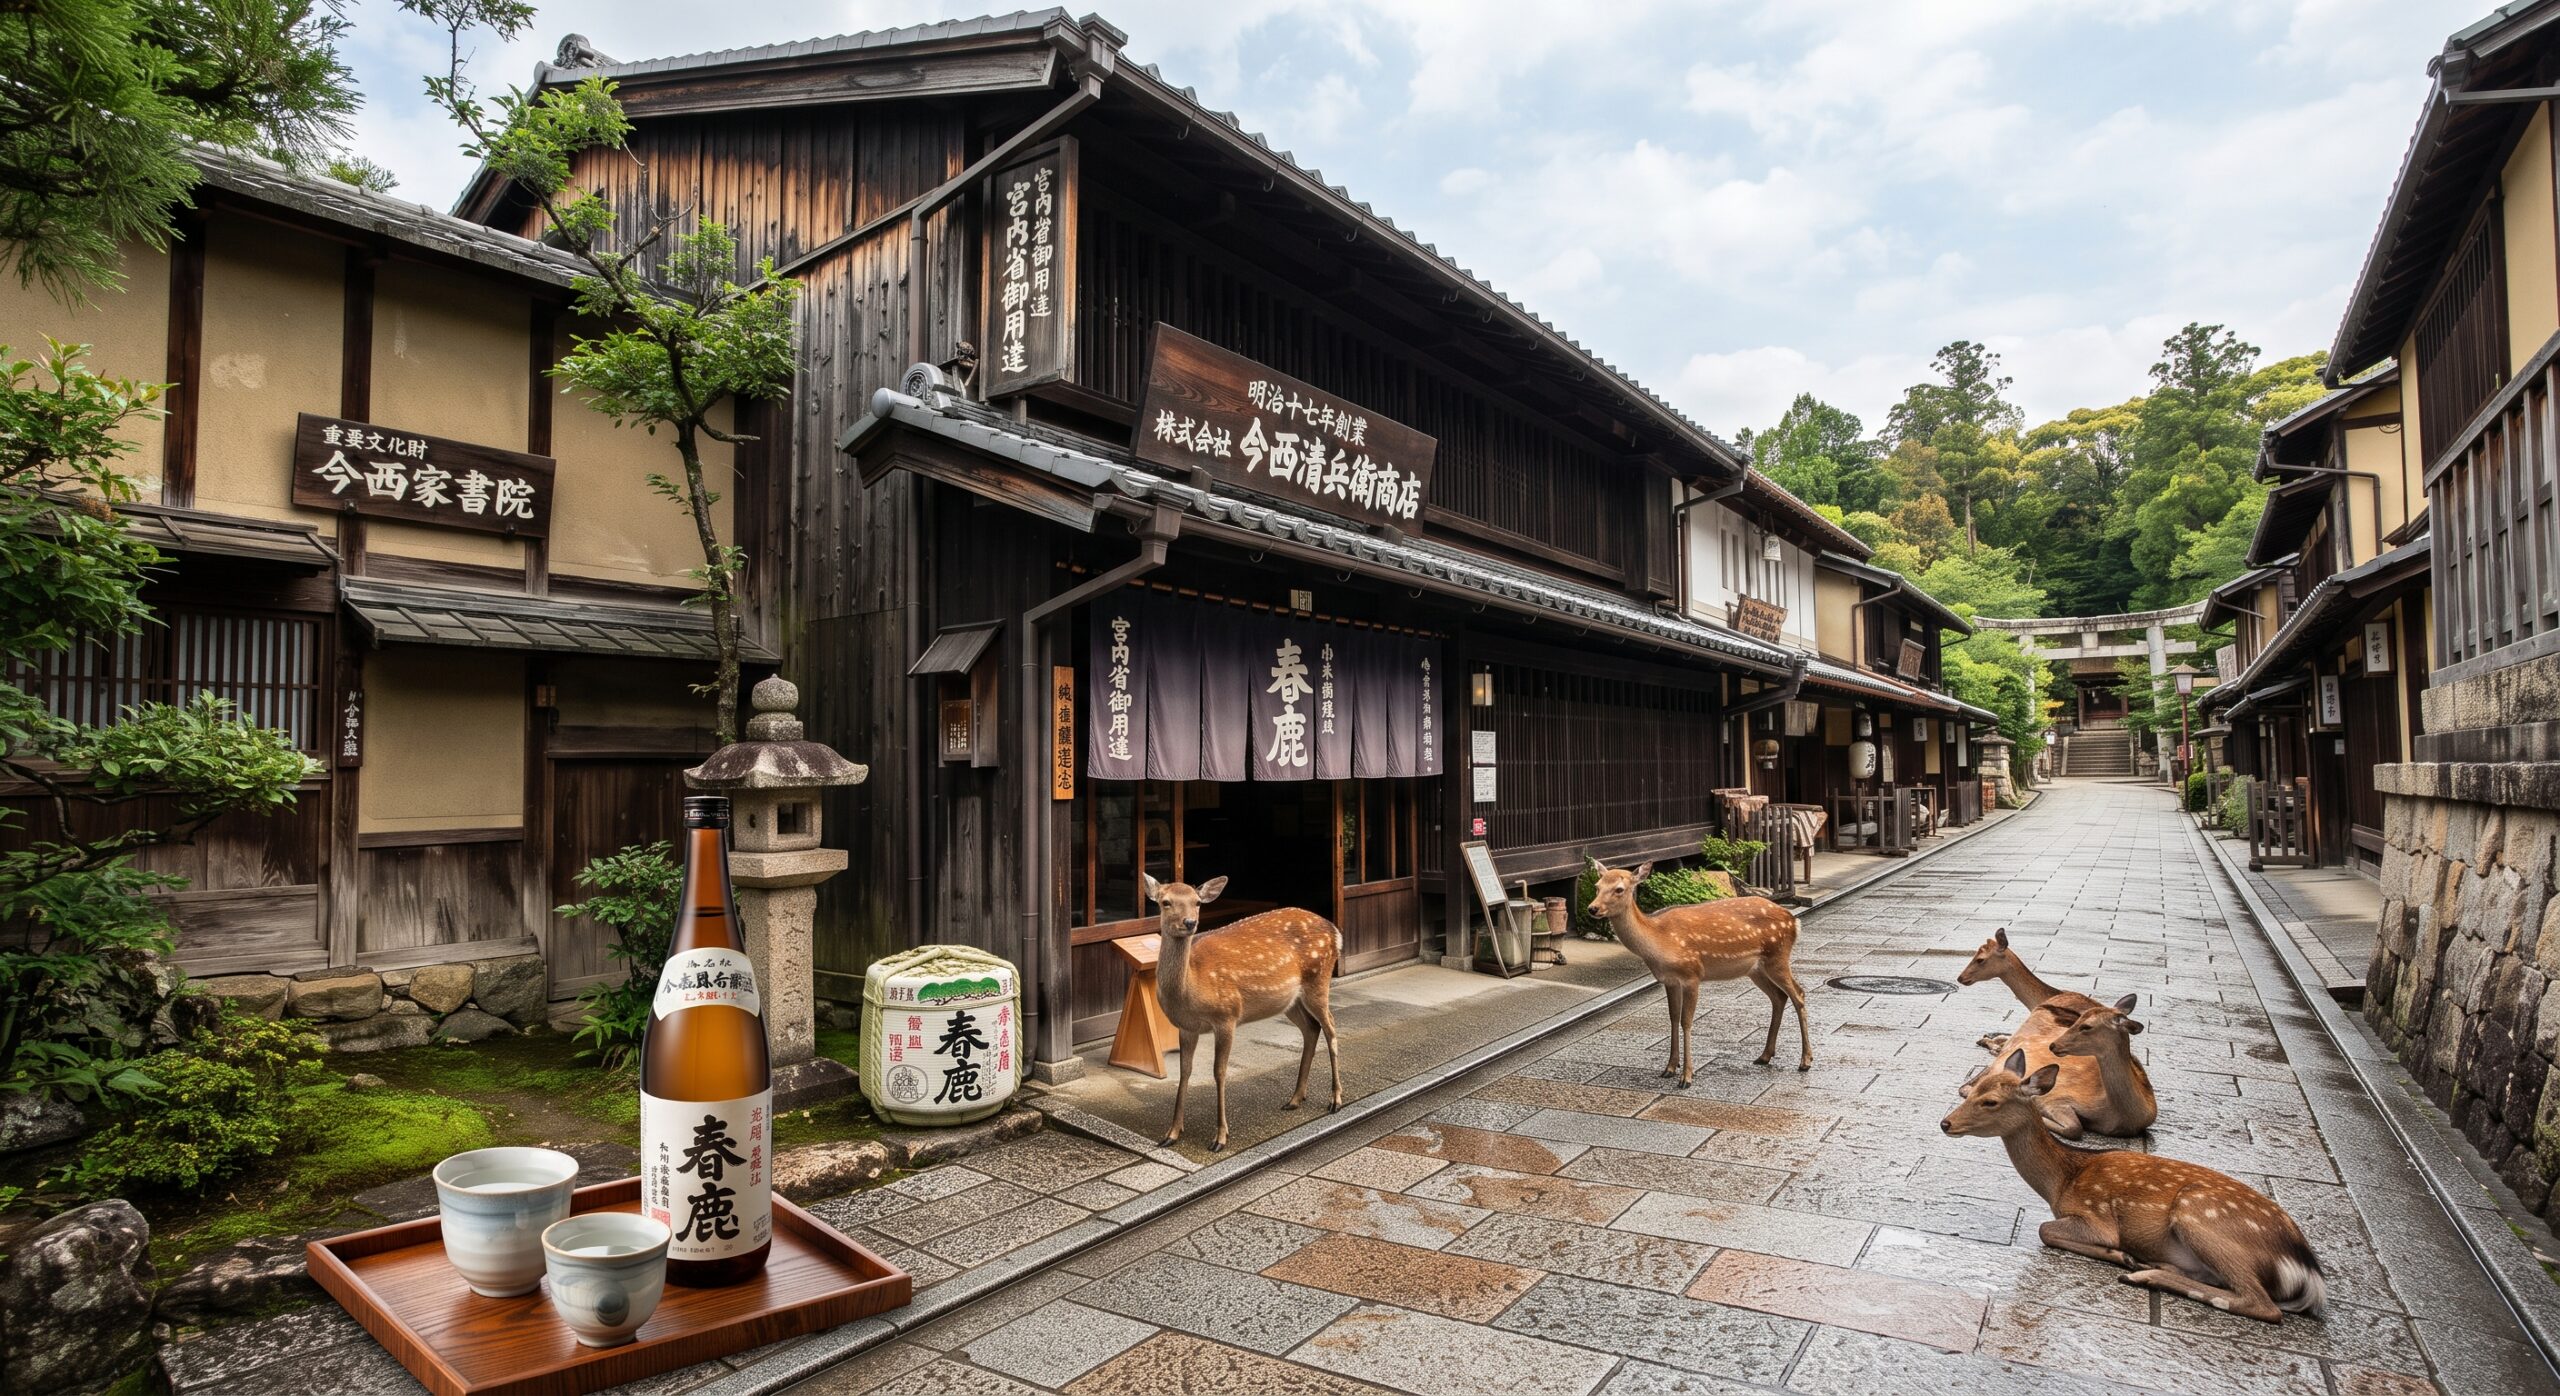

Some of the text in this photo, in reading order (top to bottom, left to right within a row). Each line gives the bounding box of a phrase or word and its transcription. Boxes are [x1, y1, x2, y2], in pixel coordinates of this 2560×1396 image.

[1000, 182, 1031, 373] 宮内省御用達
[1030, 167, 1054, 318] 宮内省御用達
[322, 423, 429, 460] 重要文化財
[1153, 408, 1422, 520] 株式会社 今西清兵衛商店
[1247, 380, 1368, 446] 明治十七年創業
[312, 450, 537, 519] 今西家書院
[1107, 616, 1133, 761] 宮内省御用達
[1265, 638, 1314, 768] 春鹿
[933, 1009, 989, 1105] 春鹿
[675, 1114, 748, 1243] 春鹿
